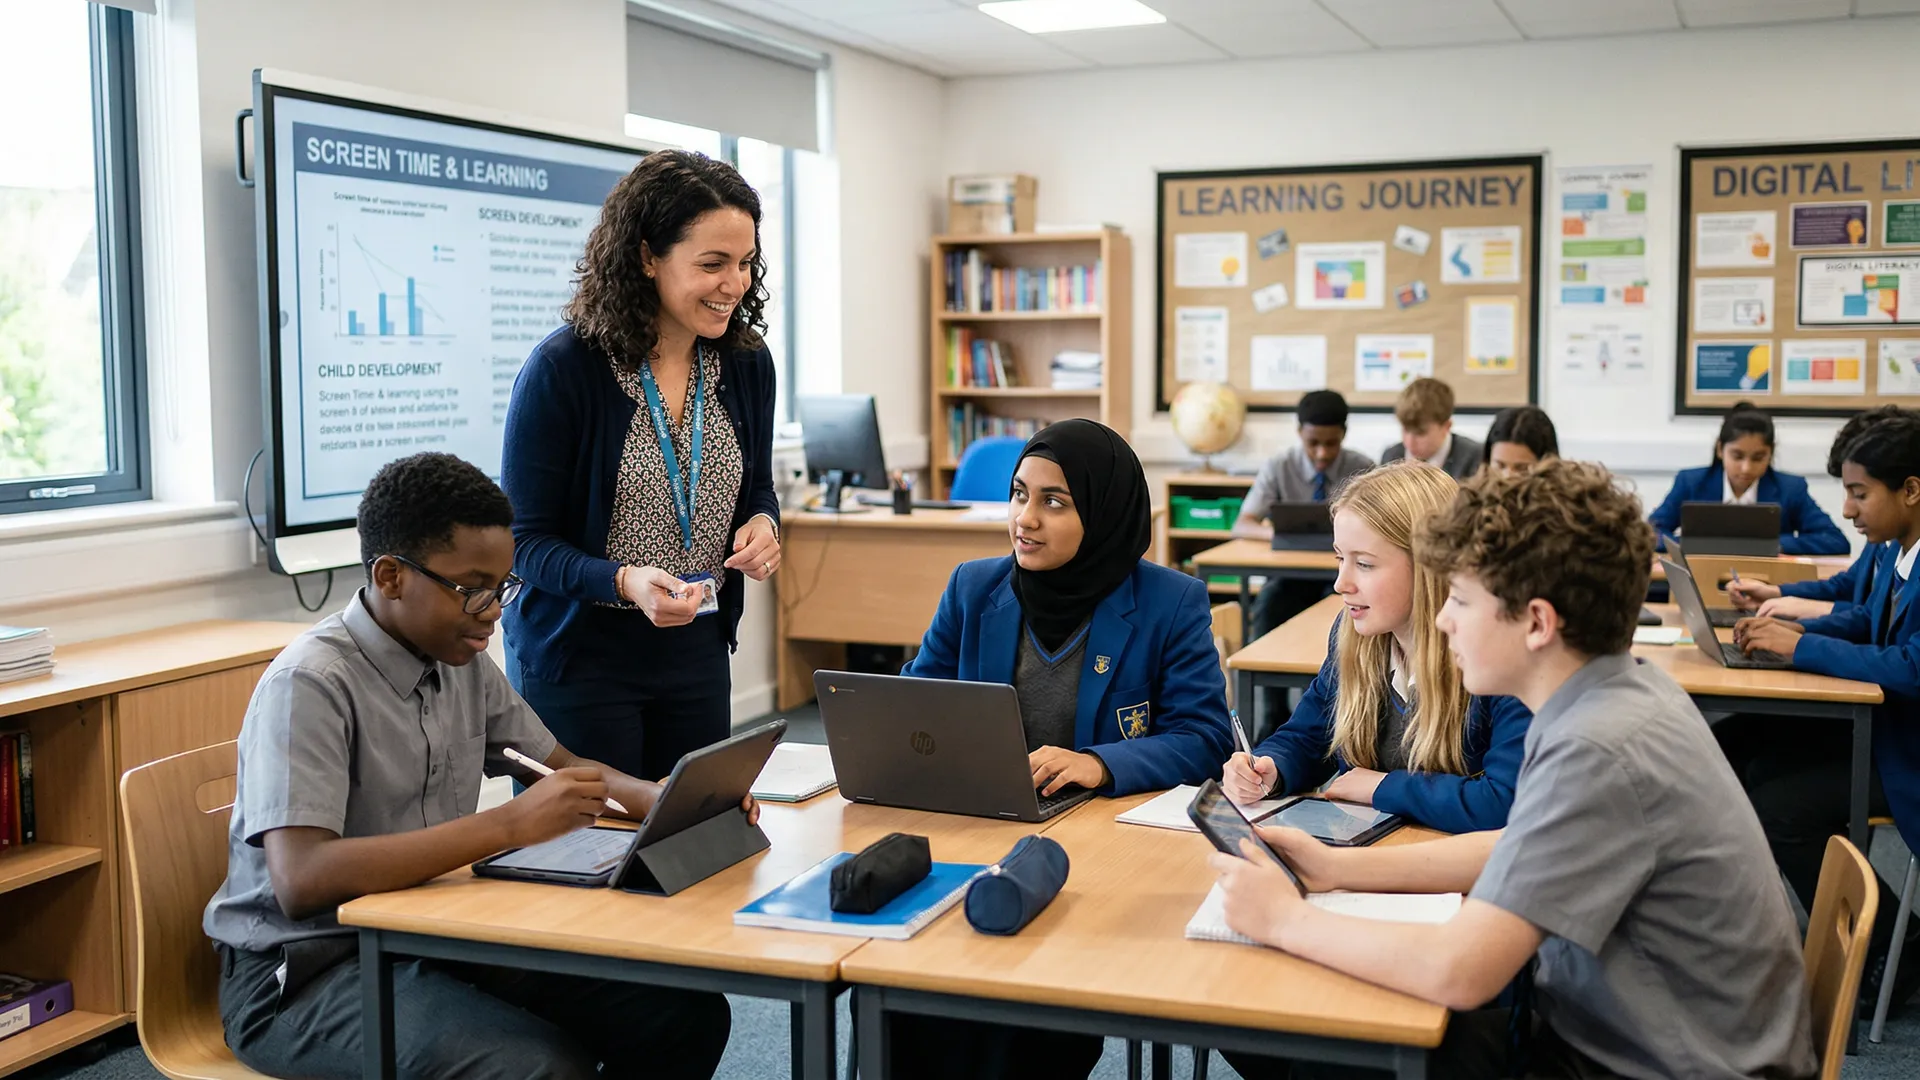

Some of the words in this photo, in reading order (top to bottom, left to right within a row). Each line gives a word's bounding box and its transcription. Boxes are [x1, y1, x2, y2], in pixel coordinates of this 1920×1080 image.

[307, 137, 391, 171] SCREEN
[396, 149, 441, 178] TIME
[445, 156, 458, 180] &
[463, 158, 549, 191] LEARNING
[1713, 161, 1863, 197] DIGITAL
[1177, 181, 1345, 216] LEARNING
[1359, 175, 1526, 210] JOURNEY
[478, 207, 517, 223] SCREEN
[318, 364, 355, 378] CHILD
[359, 362, 443, 377] DEVELOPMENT
[319, 390, 350, 401] Screen
[387, 387, 420, 400] learning
[320, 407, 350, 418] screen
